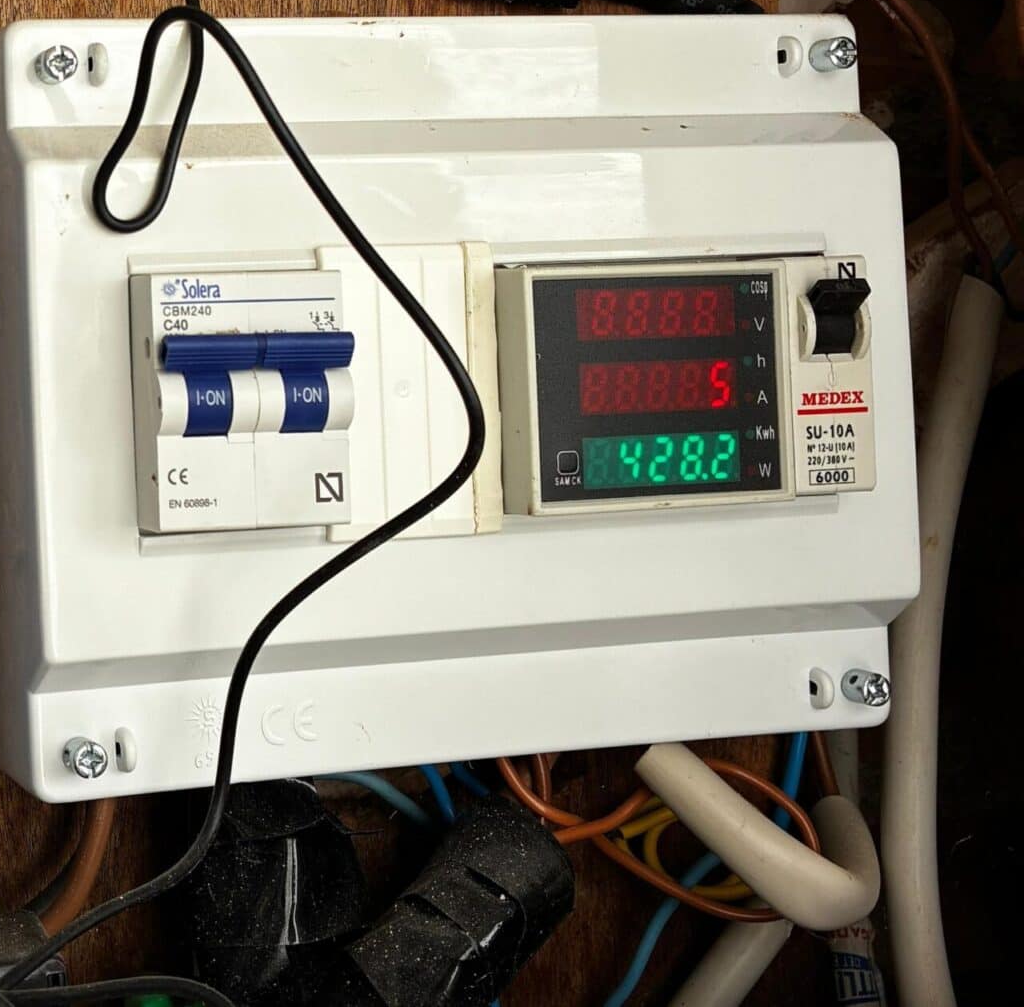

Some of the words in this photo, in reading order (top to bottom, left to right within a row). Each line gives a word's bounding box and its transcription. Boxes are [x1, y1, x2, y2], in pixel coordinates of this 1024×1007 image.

[181, 278, 221, 299] Solera
[162, 305, 212, 317] CBM240
[163, 319, 189, 331] C40
[754, 316, 765, 332] V
[756, 389, 768, 405] A
[801, 390, 865, 406] MEDEX
[806, 423, 855, 440] SU-10A
[619, 433, 736, 482] 428.2
[758, 463, 772, 478] W
[815, 470, 849, 484] 6000
[169, 499, 182, 509] EN
